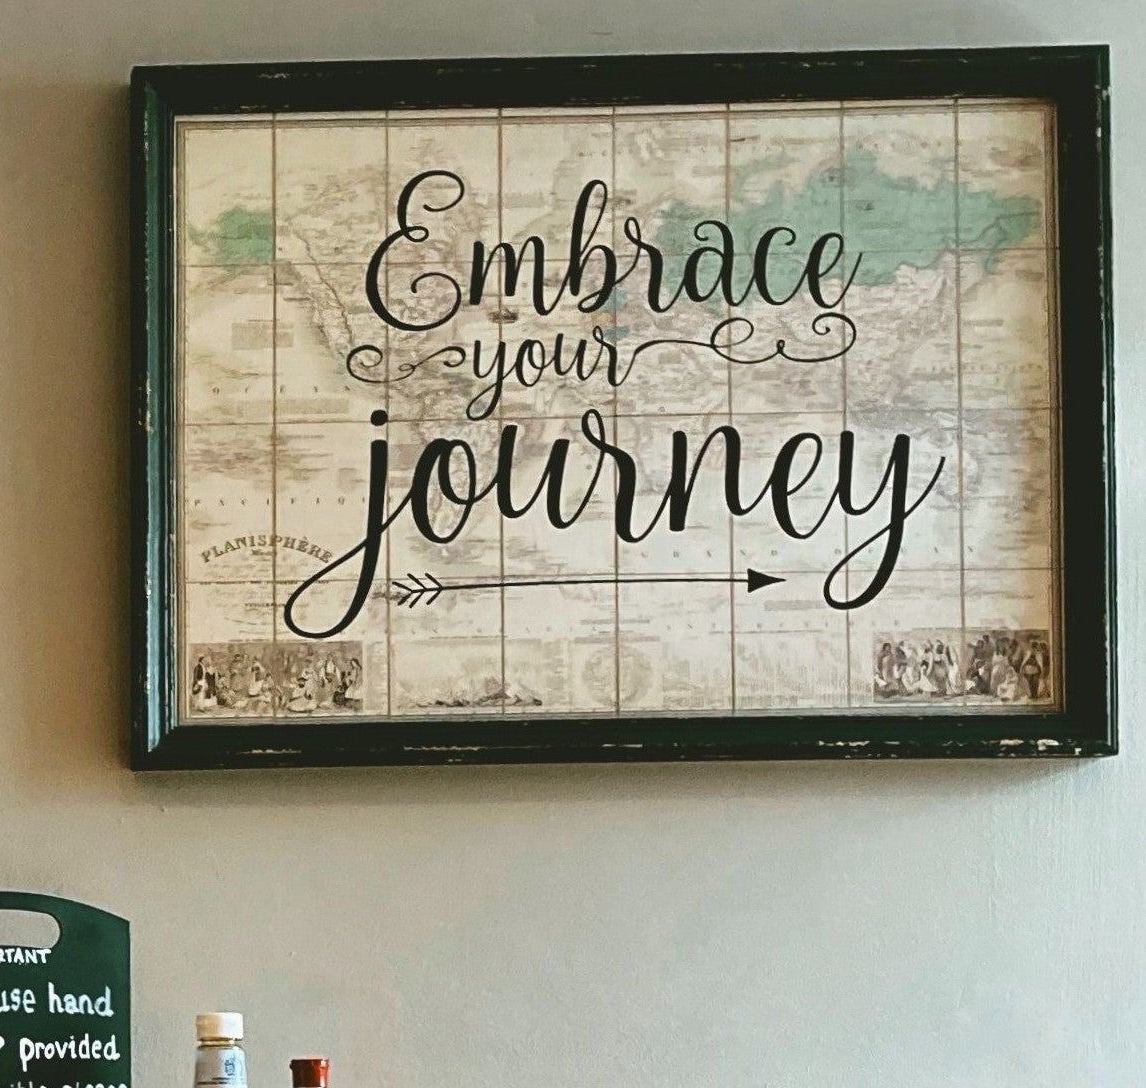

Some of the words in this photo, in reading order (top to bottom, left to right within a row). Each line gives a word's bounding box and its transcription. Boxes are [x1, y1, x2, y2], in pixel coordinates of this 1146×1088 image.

[365, 169, 863, 333] Embrace
[464, 324, 636, 421] your
[284, 409, 947, 640] journey
[48, 982, 114, 1017] hand
[19, 1032, 121, 1073] provided
